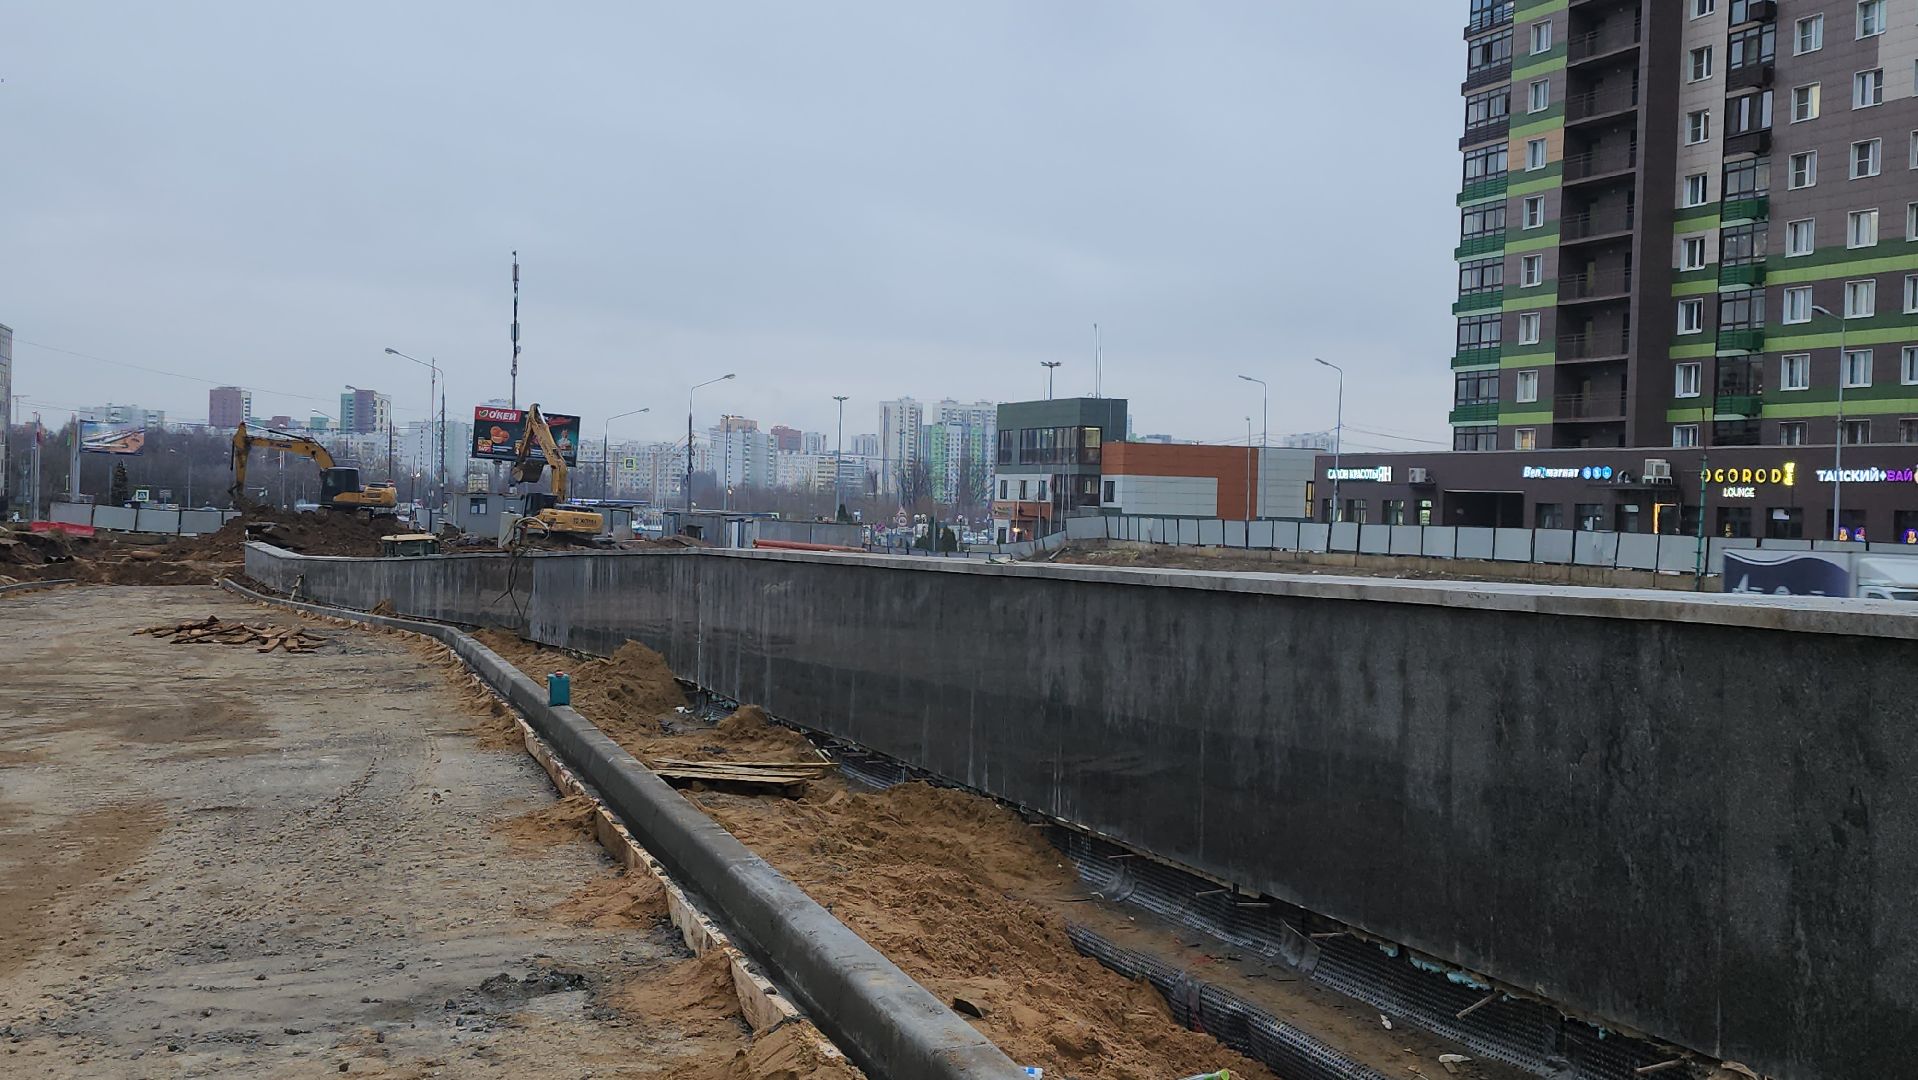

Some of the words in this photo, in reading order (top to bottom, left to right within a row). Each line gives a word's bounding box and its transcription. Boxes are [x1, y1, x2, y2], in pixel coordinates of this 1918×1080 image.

[1816, 467, 1880, 482] ТАЙСКИЙ
[1886, 468, 1913, 482] ВАЙ
[1723, 487, 1754, 498] LOUNGE
